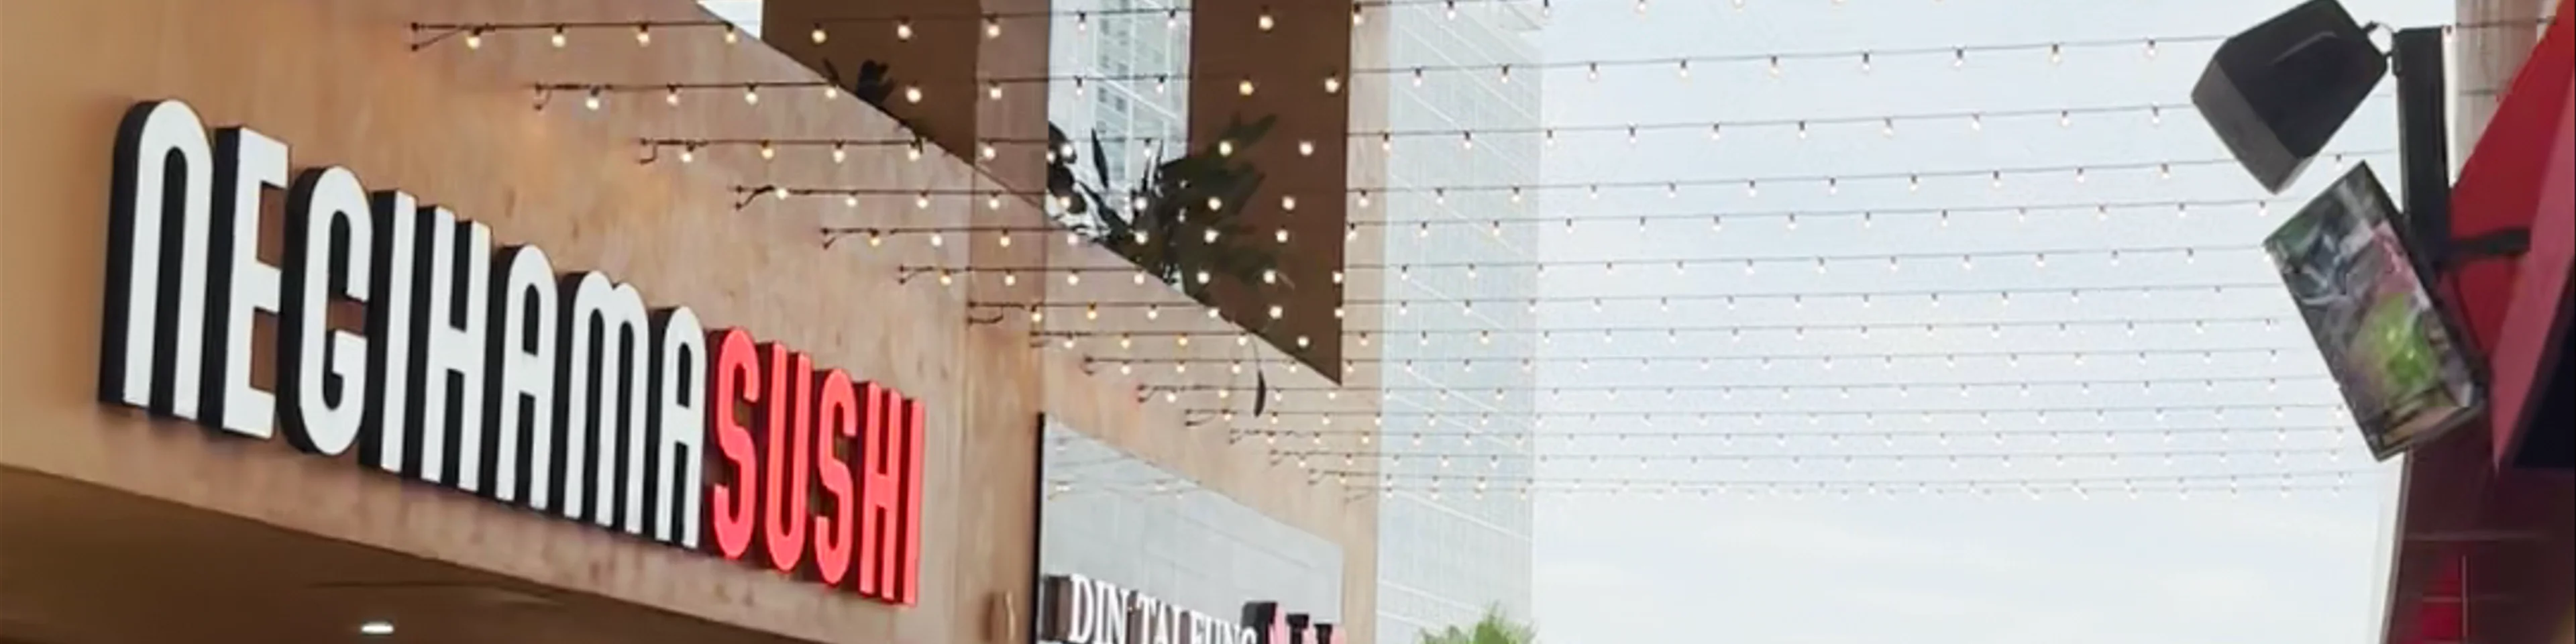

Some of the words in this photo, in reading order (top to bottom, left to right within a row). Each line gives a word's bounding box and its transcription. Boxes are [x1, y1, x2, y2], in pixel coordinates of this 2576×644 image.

[114, 99, 706, 549] NEGIHAMA
[712, 327, 925, 606] SUSHI
[1069, 573, 1130, 644] DIN
[1136, 590, 1183, 644] TAI
